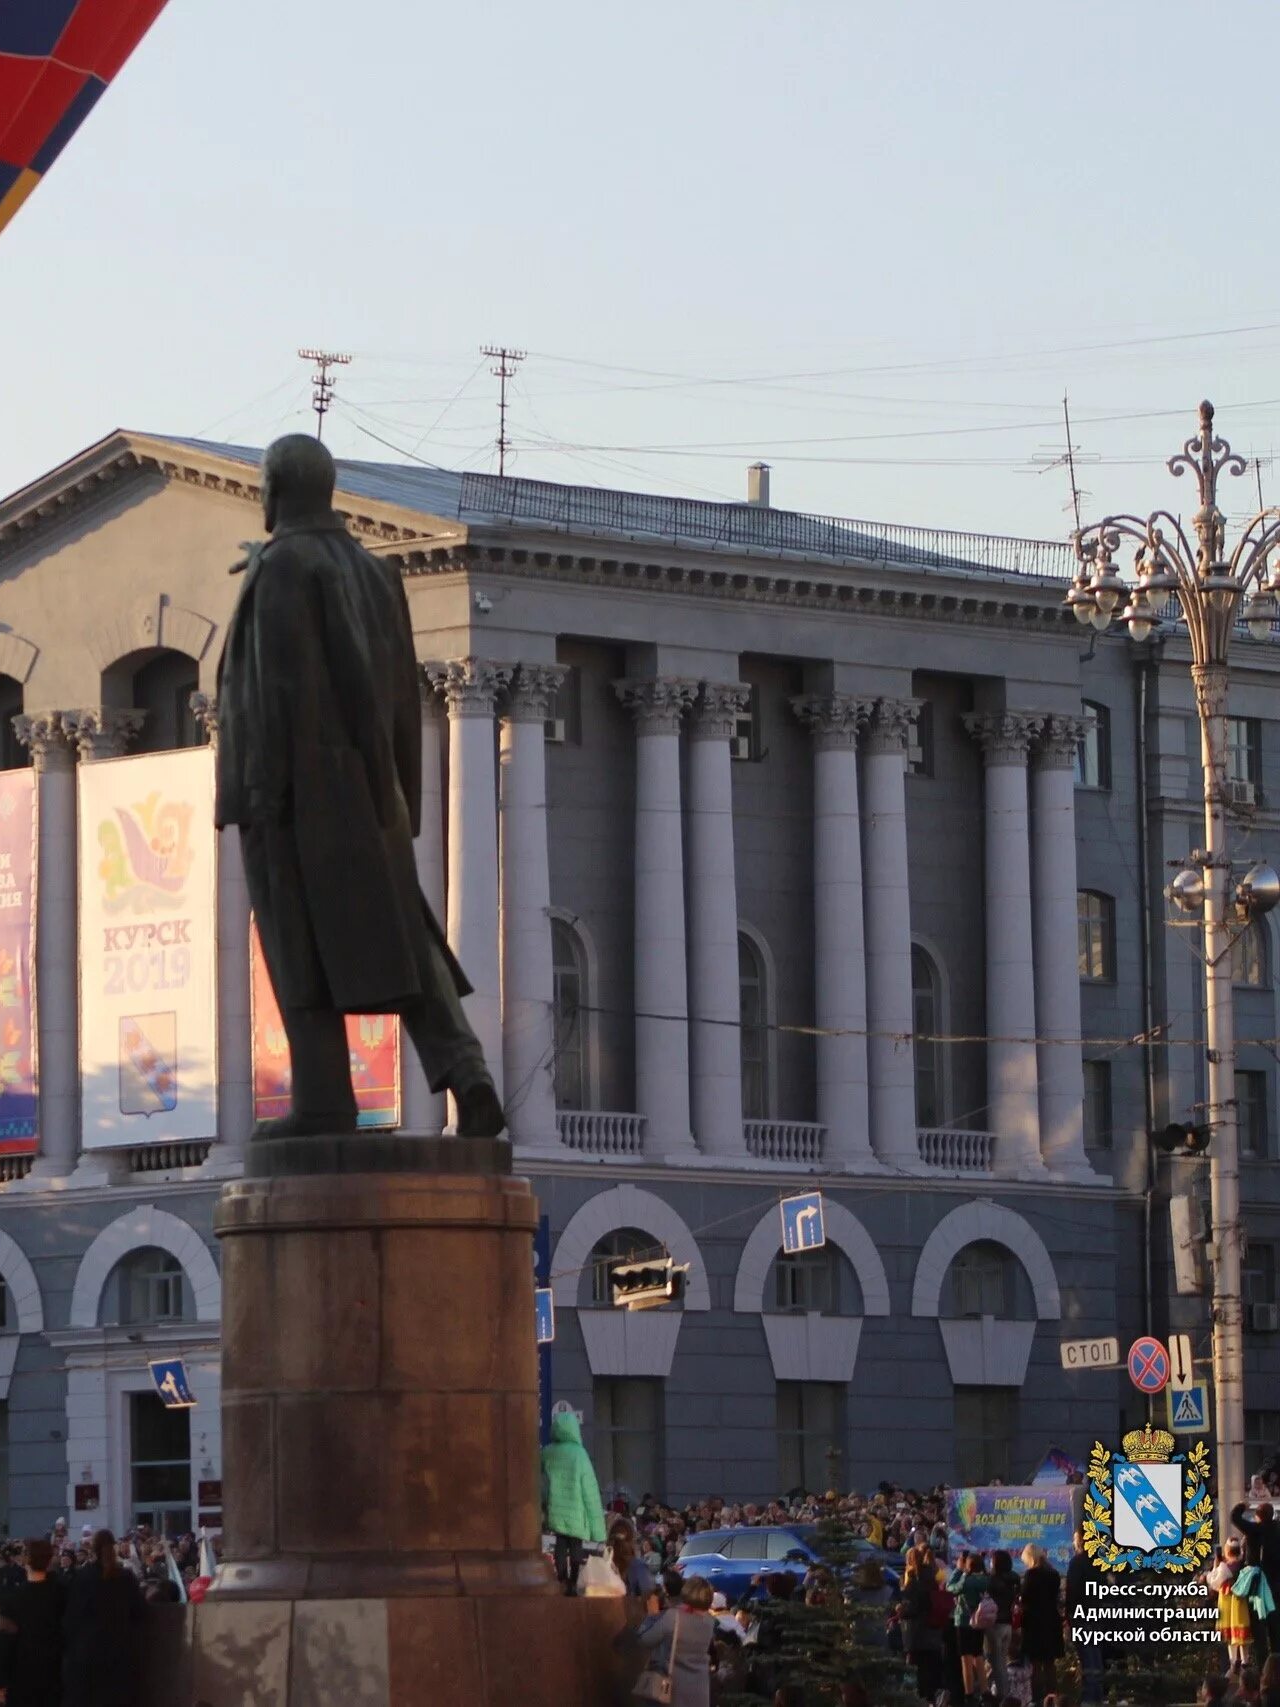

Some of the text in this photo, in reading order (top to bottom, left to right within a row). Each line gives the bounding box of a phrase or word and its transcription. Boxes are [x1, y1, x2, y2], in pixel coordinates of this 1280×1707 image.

[103, 919, 192, 951] КУРСК
[103, 947, 192, 995] 2019
[1067, 1343, 1111, 1364] СТОП
[1040, 1513, 1067, 1525] ШАРЕ
